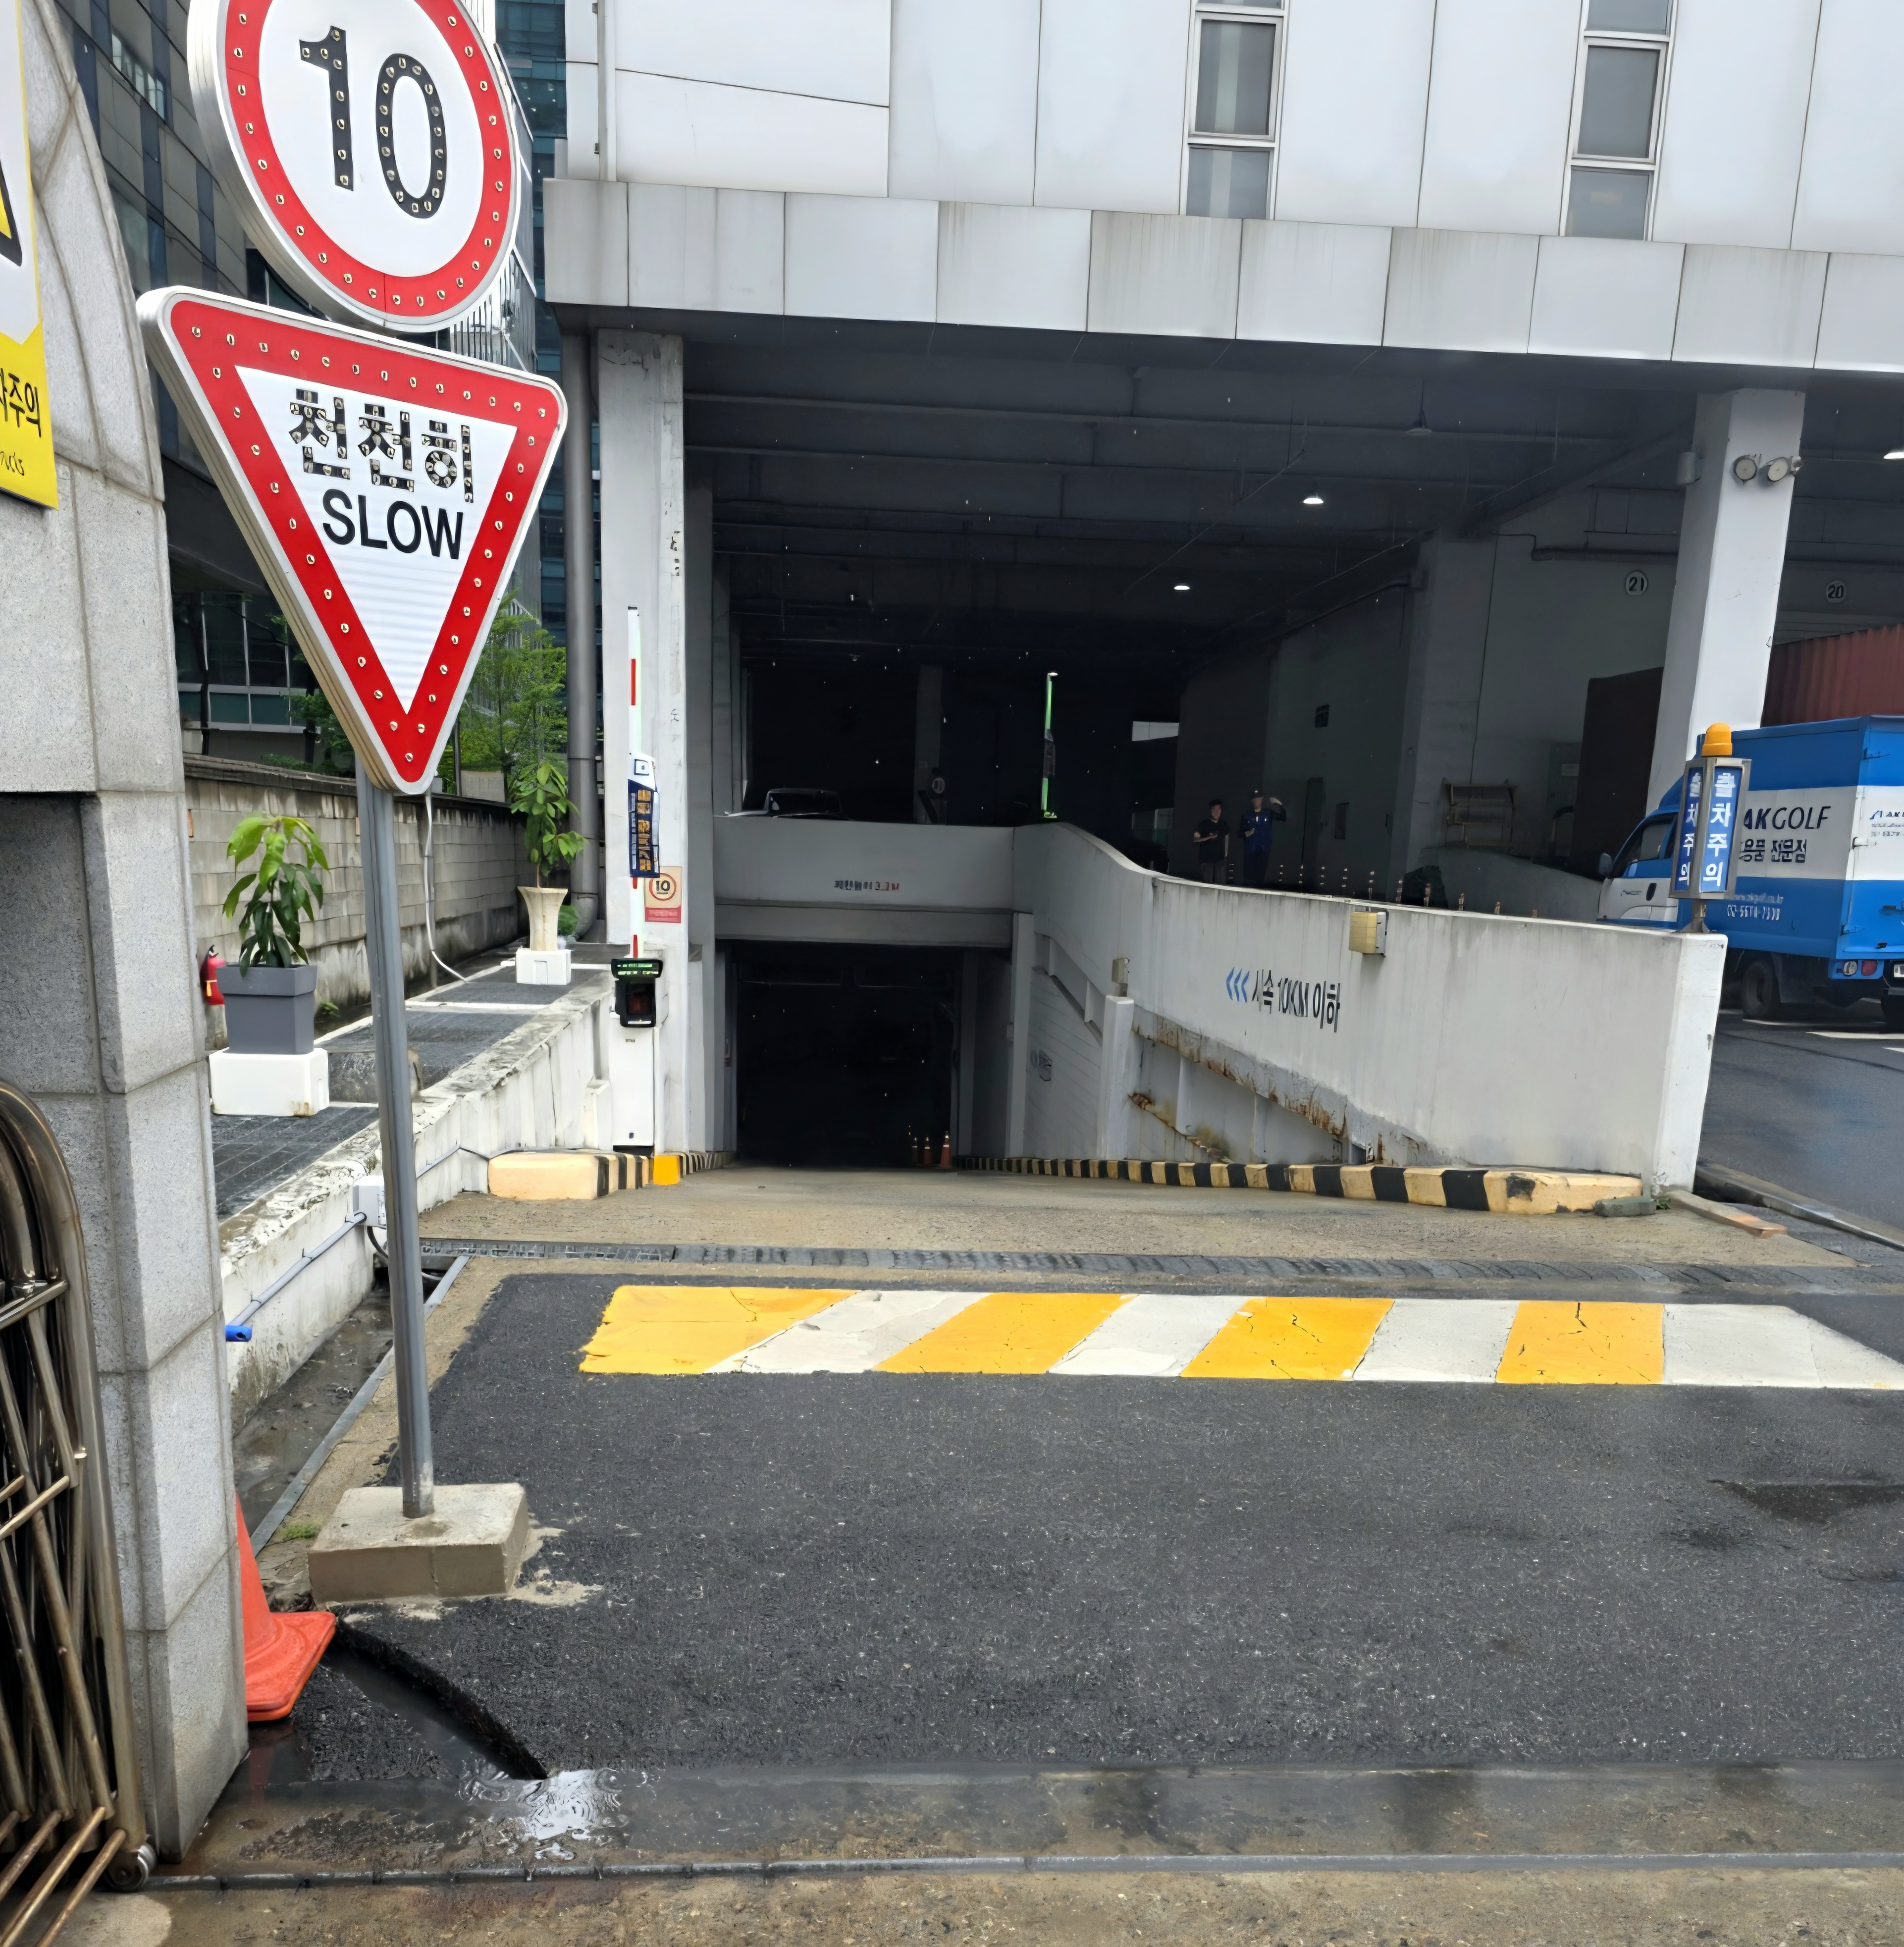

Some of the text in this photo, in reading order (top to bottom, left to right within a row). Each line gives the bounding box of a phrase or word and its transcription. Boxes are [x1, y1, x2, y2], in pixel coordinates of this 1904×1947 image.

[299, 25, 447, 219] 10
[288, 388, 474, 503] 천천히
[322, 488, 464, 559] SLOW
[1629, 576, 1644, 592] 21
[1827, 585, 1844, 598] 20
[655, 880, 671, 892] 10
[1251, 969, 1274, 1014] 시속
[1313, 980, 1341, 1033] 이하
